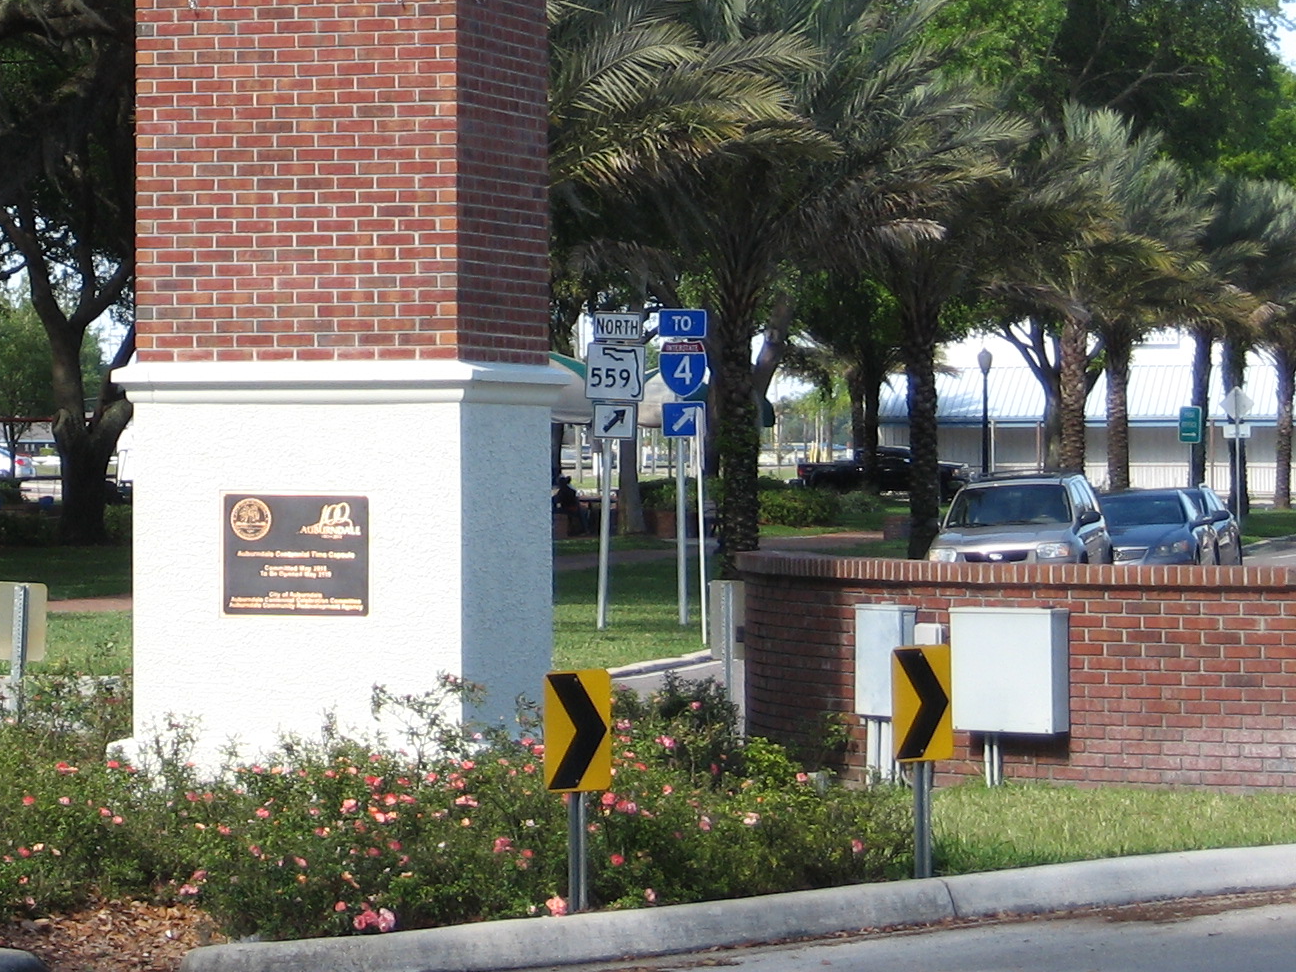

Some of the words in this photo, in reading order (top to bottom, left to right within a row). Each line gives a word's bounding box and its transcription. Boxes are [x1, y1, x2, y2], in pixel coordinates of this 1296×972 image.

[596, 317, 639, 336] NORTH
[671, 316, 692, 332] TO
[590, 367, 631, 388] 559
[673, 355, 693, 385] 4
